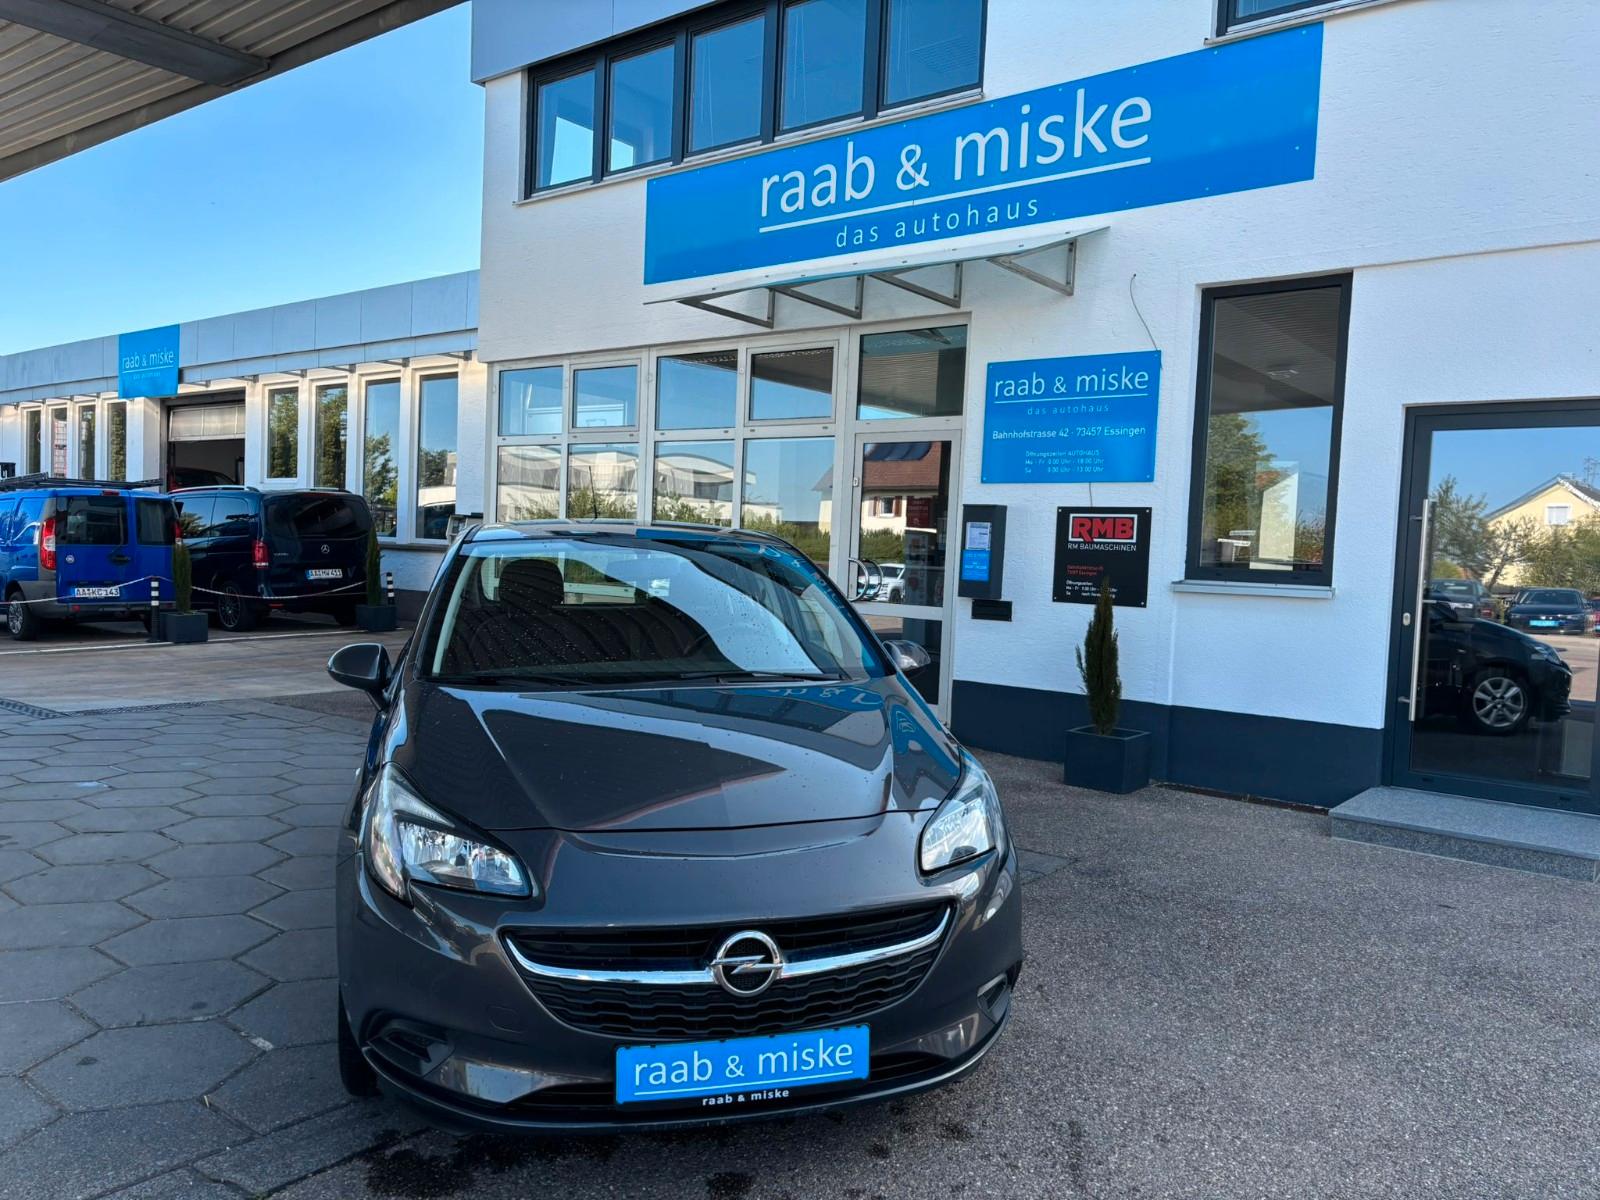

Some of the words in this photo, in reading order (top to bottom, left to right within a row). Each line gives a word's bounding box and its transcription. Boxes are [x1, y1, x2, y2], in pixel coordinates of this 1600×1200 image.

[760, 141, 876, 217] raab
[895, 144, 930, 191] &
[954, 88, 1152, 181] miske
[836, 224, 879, 248] das
[895, 198, 1039, 238] autohaus
[122, 352, 140, 369] raab
[150, 347, 174, 365] miske
[994, 371, 1045, 398] raab
[1053, 376, 1067, 394] &
[1076, 365, 1149, 392] miske
[1027, 406, 1047, 416] das
[1052, 404, 1109, 415] autohaus
[992, 430, 1057, 440] Bahnhofstrasse
[1058, 428, 1069, 437] 42
[1076, 427, 1102, 437] 73457
[1104, 426, 1146, 439] Essingen
[1072, 517, 1134, 543] RMB
[1067, 542, 1078, 550] RM
[1080, 543, 1137, 552] BAUMASCHINEN
[634, 1050, 713, 1087] raab
[725, 1055, 745, 1079] &
[758, 1038, 853, 1076] miske
[702, 1093, 733, 1107] raab
[751, 1088, 790, 1101] miske
